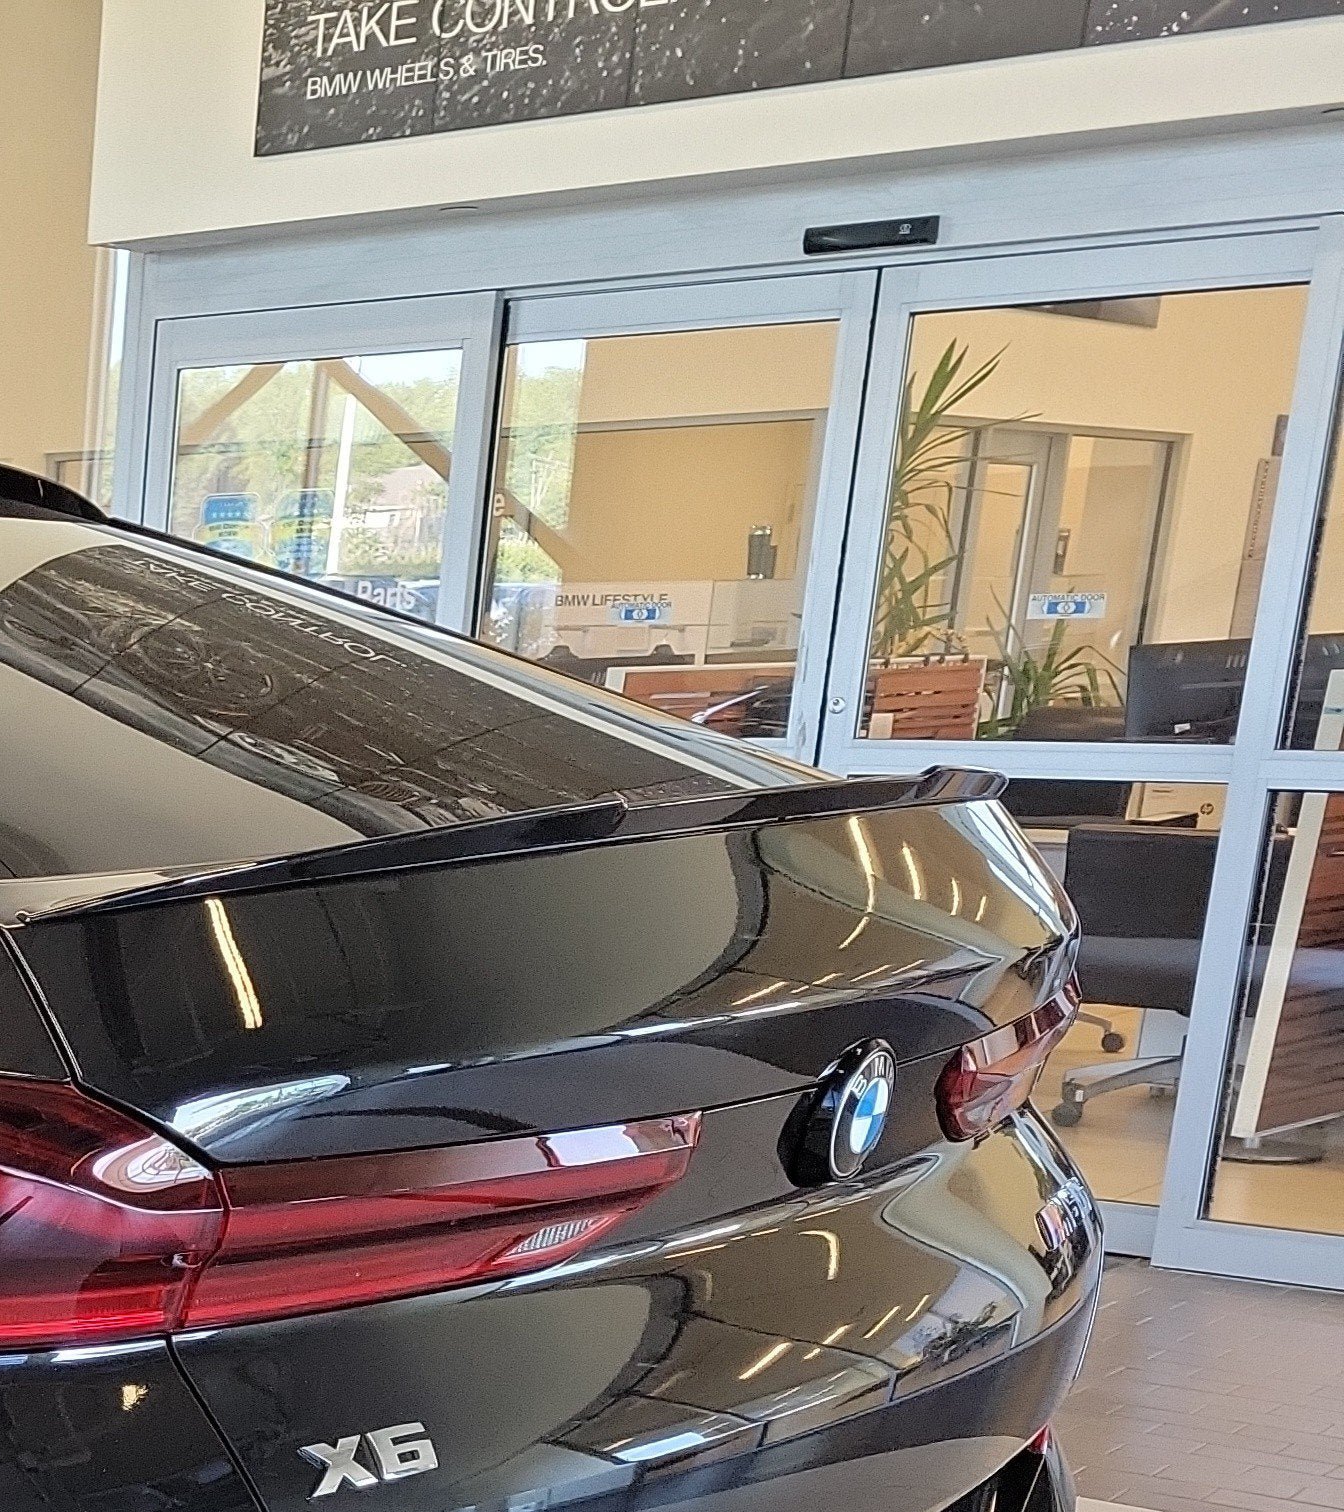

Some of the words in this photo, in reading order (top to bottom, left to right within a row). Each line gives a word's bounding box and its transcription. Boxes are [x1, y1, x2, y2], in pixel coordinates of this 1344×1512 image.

[307, 0, 417, 57] TAKE
[432, 0, 678, 38] CONT
[306, 71, 362, 100] BMW
[367, 58, 455, 91] WHEELS
[460, 54, 476, 77] &
[483, 44, 547, 73] TIRES.
[555, 594, 590, 607] BMW
[592, 593, 669, 607] LIFESTYLE
[1081, 593, 1105, 601] DOOR
[297, 1421, 439, 1500] X6
